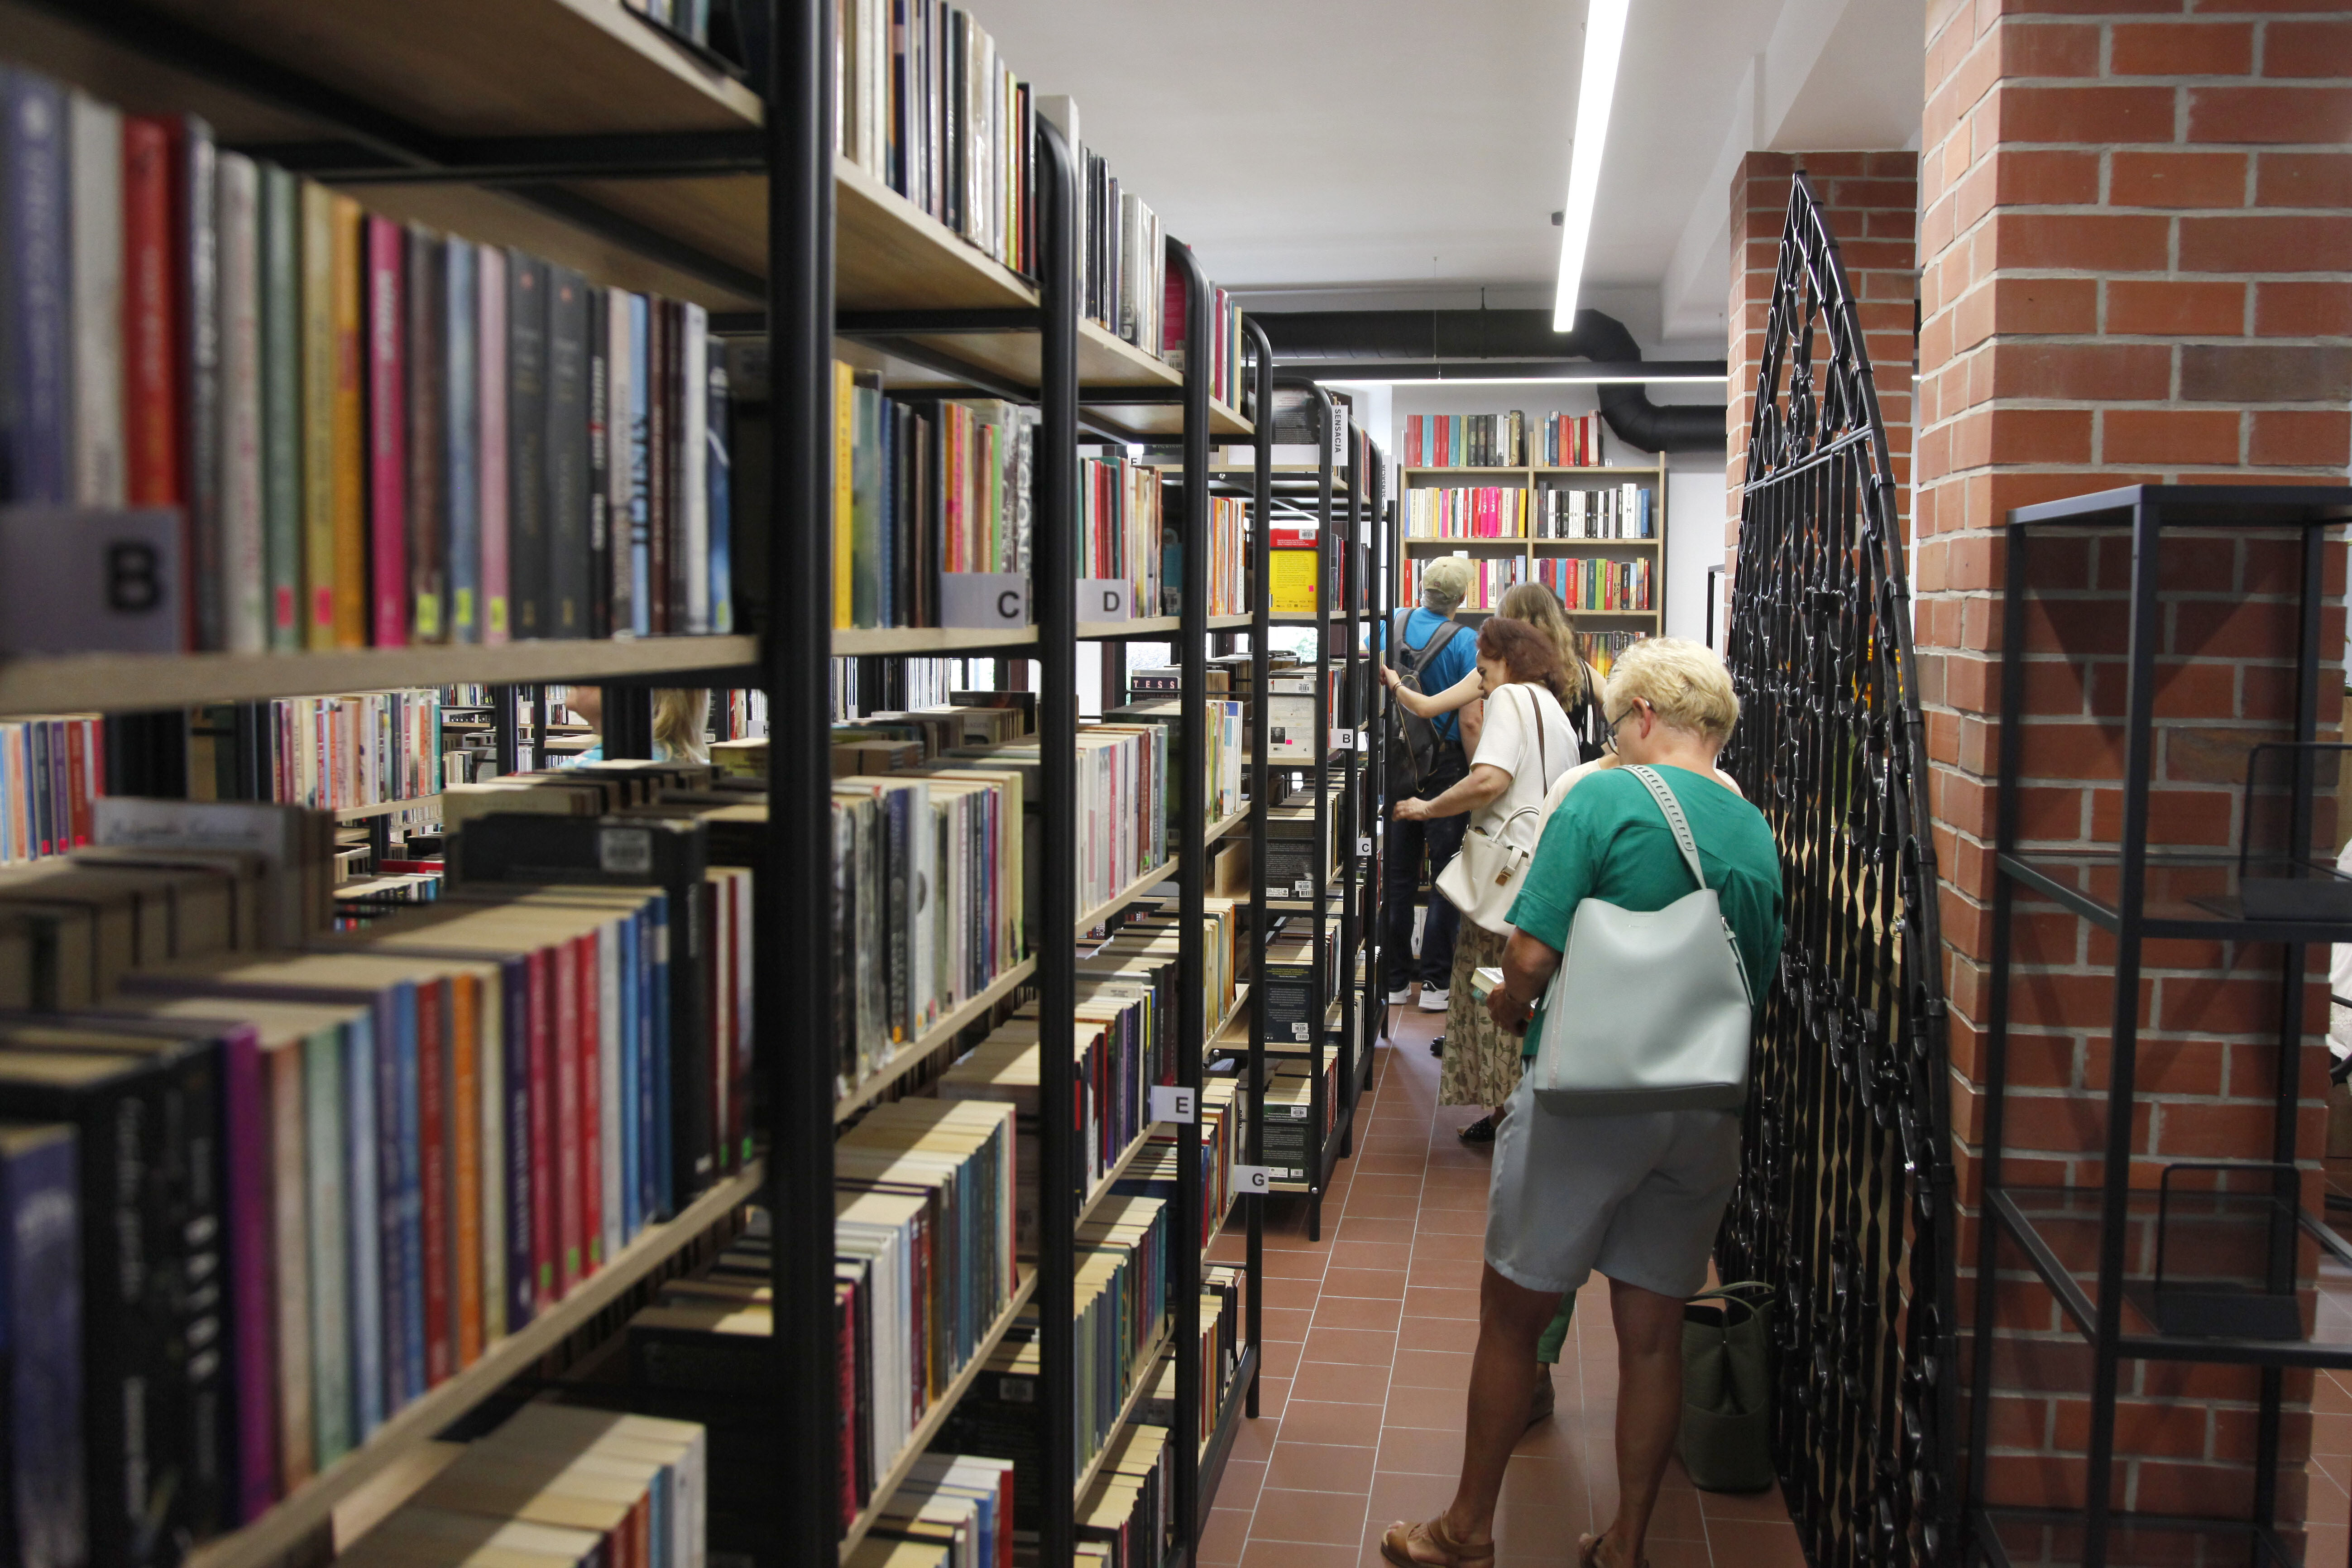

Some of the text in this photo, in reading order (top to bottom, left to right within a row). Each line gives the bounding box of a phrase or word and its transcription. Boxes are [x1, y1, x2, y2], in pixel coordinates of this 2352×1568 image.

[1483, 505, 1487, 513] 2
[108, 542, 163, 611] B
[997, 591, 1019, 618] C
[1103, 591, 1120, 612] D
[1134, 680, 1175, 689] TESS
[1342, 734, 1351, 743] B
[1362, 843, 1369, 852] C
[1176, 1097, 1188, 1114] E
[1252, 1173, 1265, 1187] G
